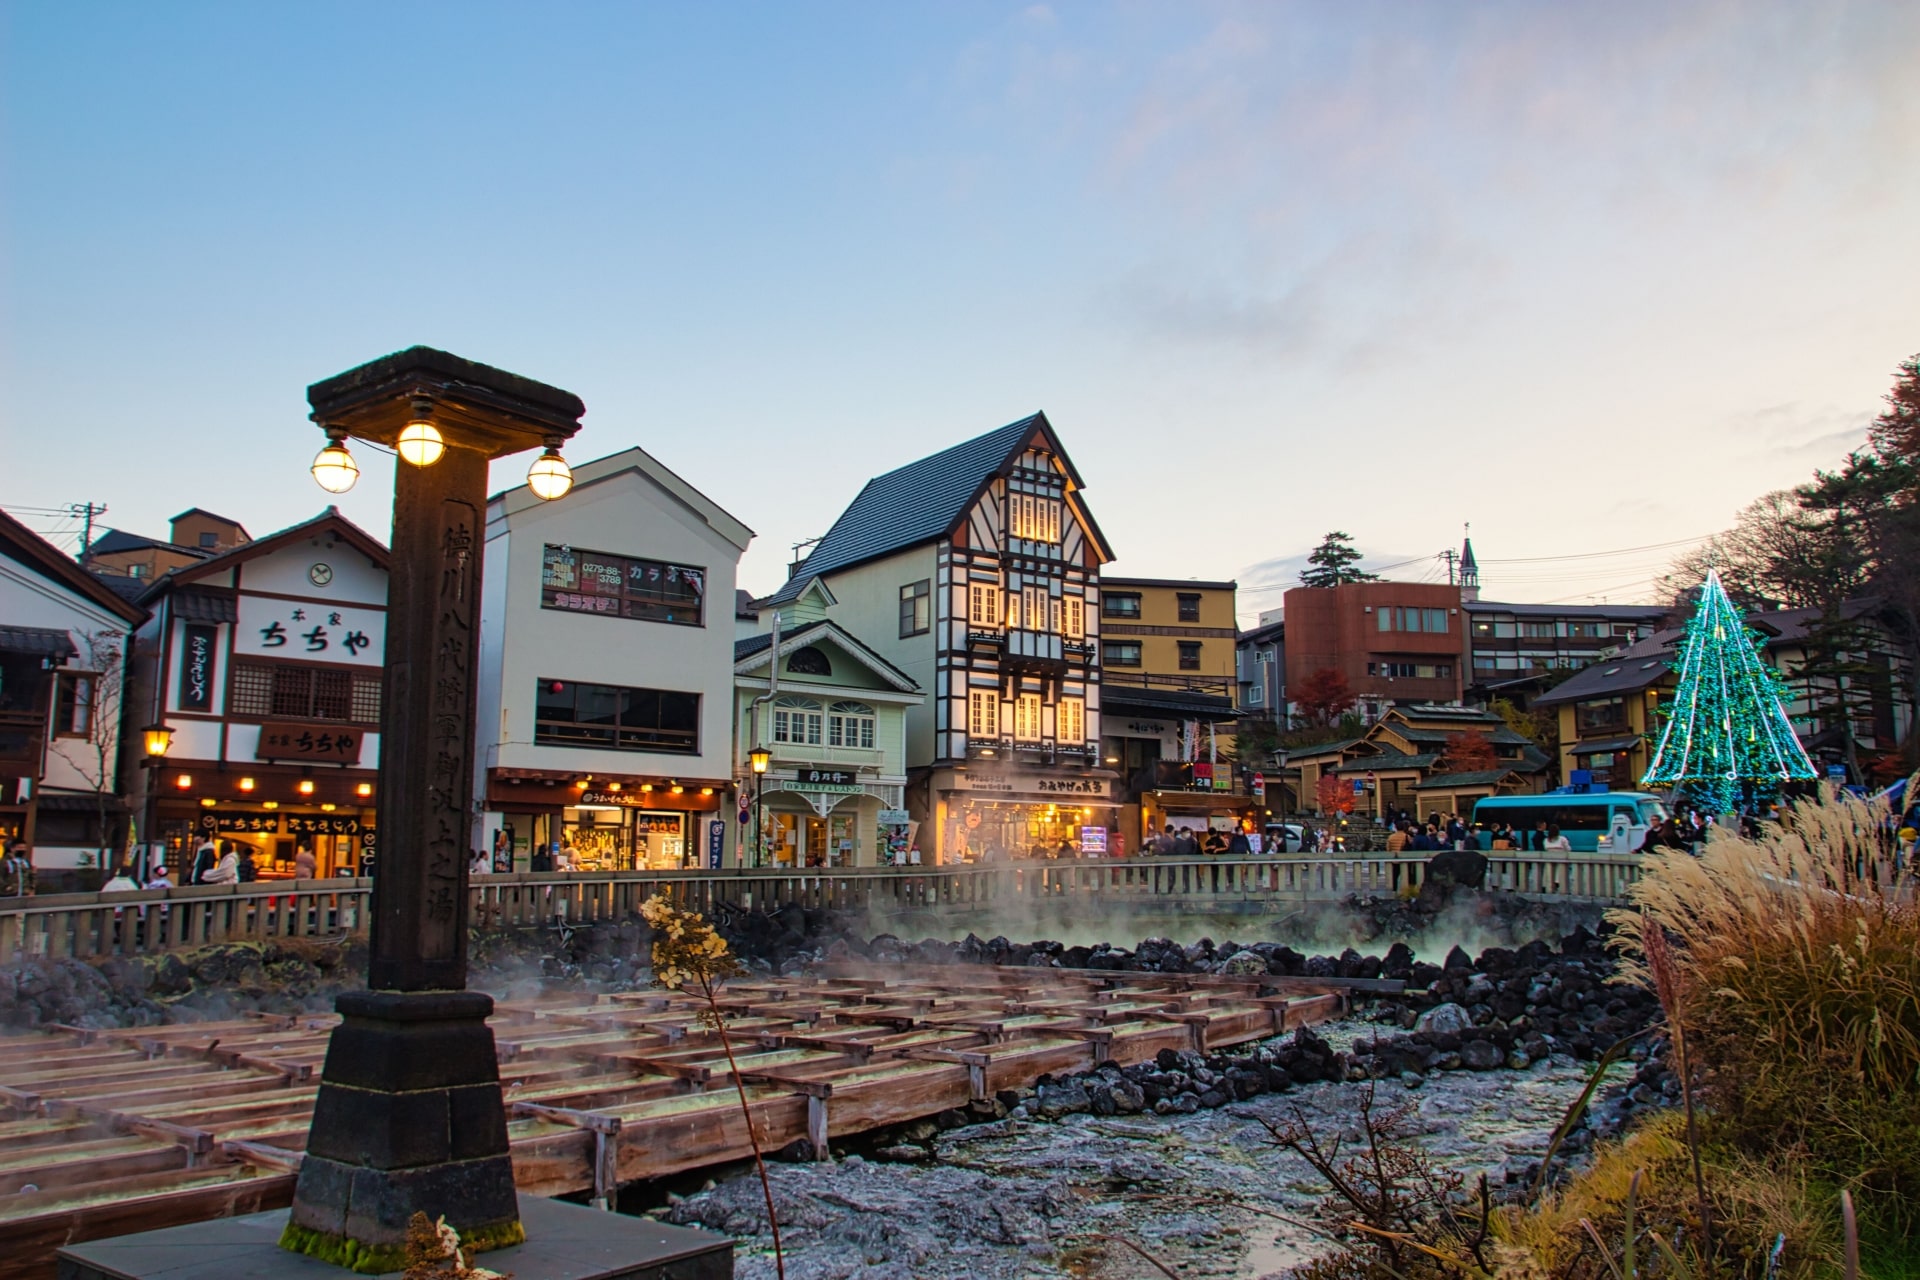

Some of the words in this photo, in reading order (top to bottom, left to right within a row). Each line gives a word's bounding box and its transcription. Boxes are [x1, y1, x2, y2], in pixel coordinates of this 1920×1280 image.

[582, 562, 622, 577] 0279-88-
[599, 575, 622, 585] 3788
[259, 621, 369, 656] ちちや
